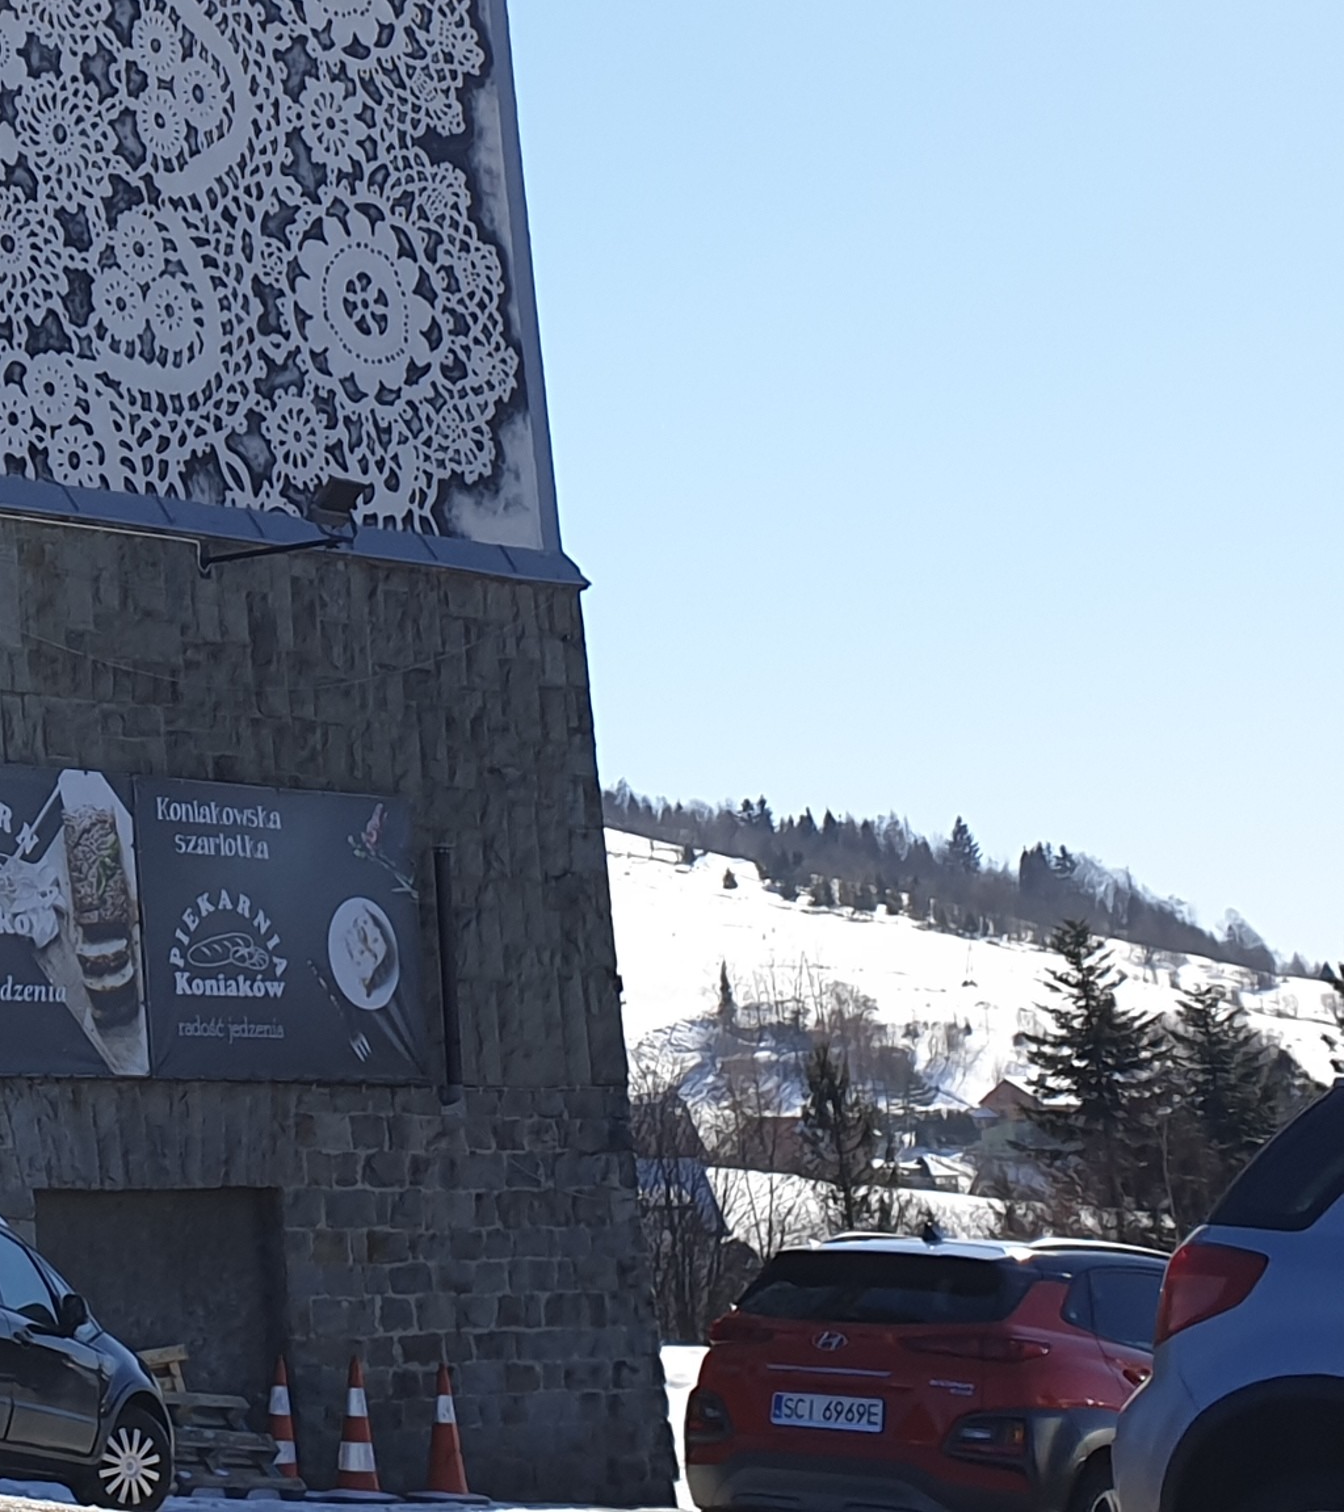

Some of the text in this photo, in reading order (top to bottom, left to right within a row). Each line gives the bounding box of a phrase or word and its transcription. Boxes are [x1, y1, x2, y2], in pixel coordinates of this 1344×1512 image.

[156, 796, 282, 830] Koniakowska
[169, 888, 288, 978] PIEKARNIA
[174, 970, 286, 999] Koniaków
[178, 1015, 285, 1045] radość jedzenia
[783, 1397, 880, 1427] SCI 6969E
